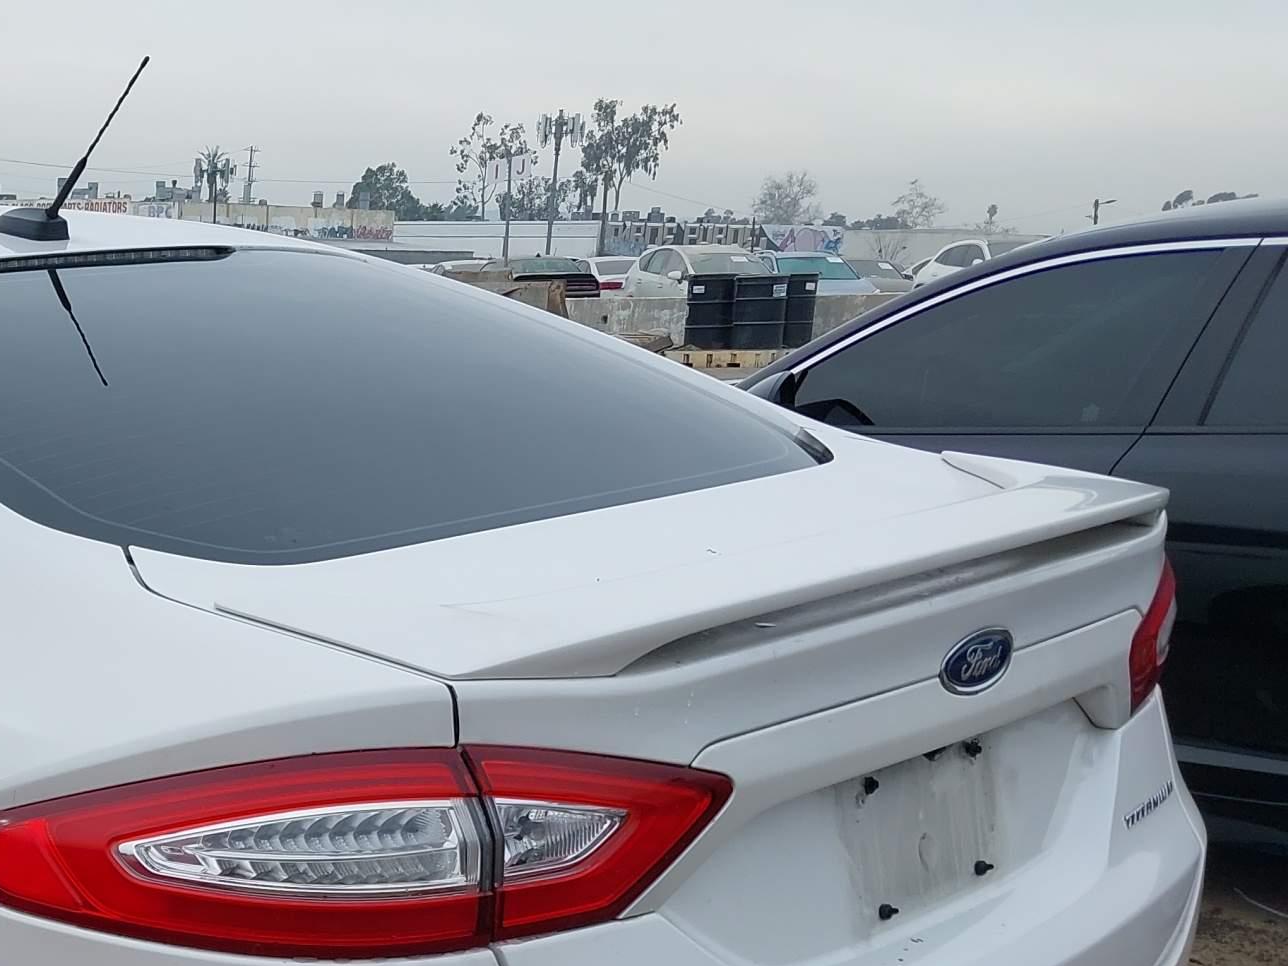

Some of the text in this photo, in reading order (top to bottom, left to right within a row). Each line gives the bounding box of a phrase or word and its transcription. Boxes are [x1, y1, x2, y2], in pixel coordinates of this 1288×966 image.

[516, 159, 525, 175] J
[961, 640, 1003, 680] Ford
[1122, 781, 1173, 830] TITANIUM
